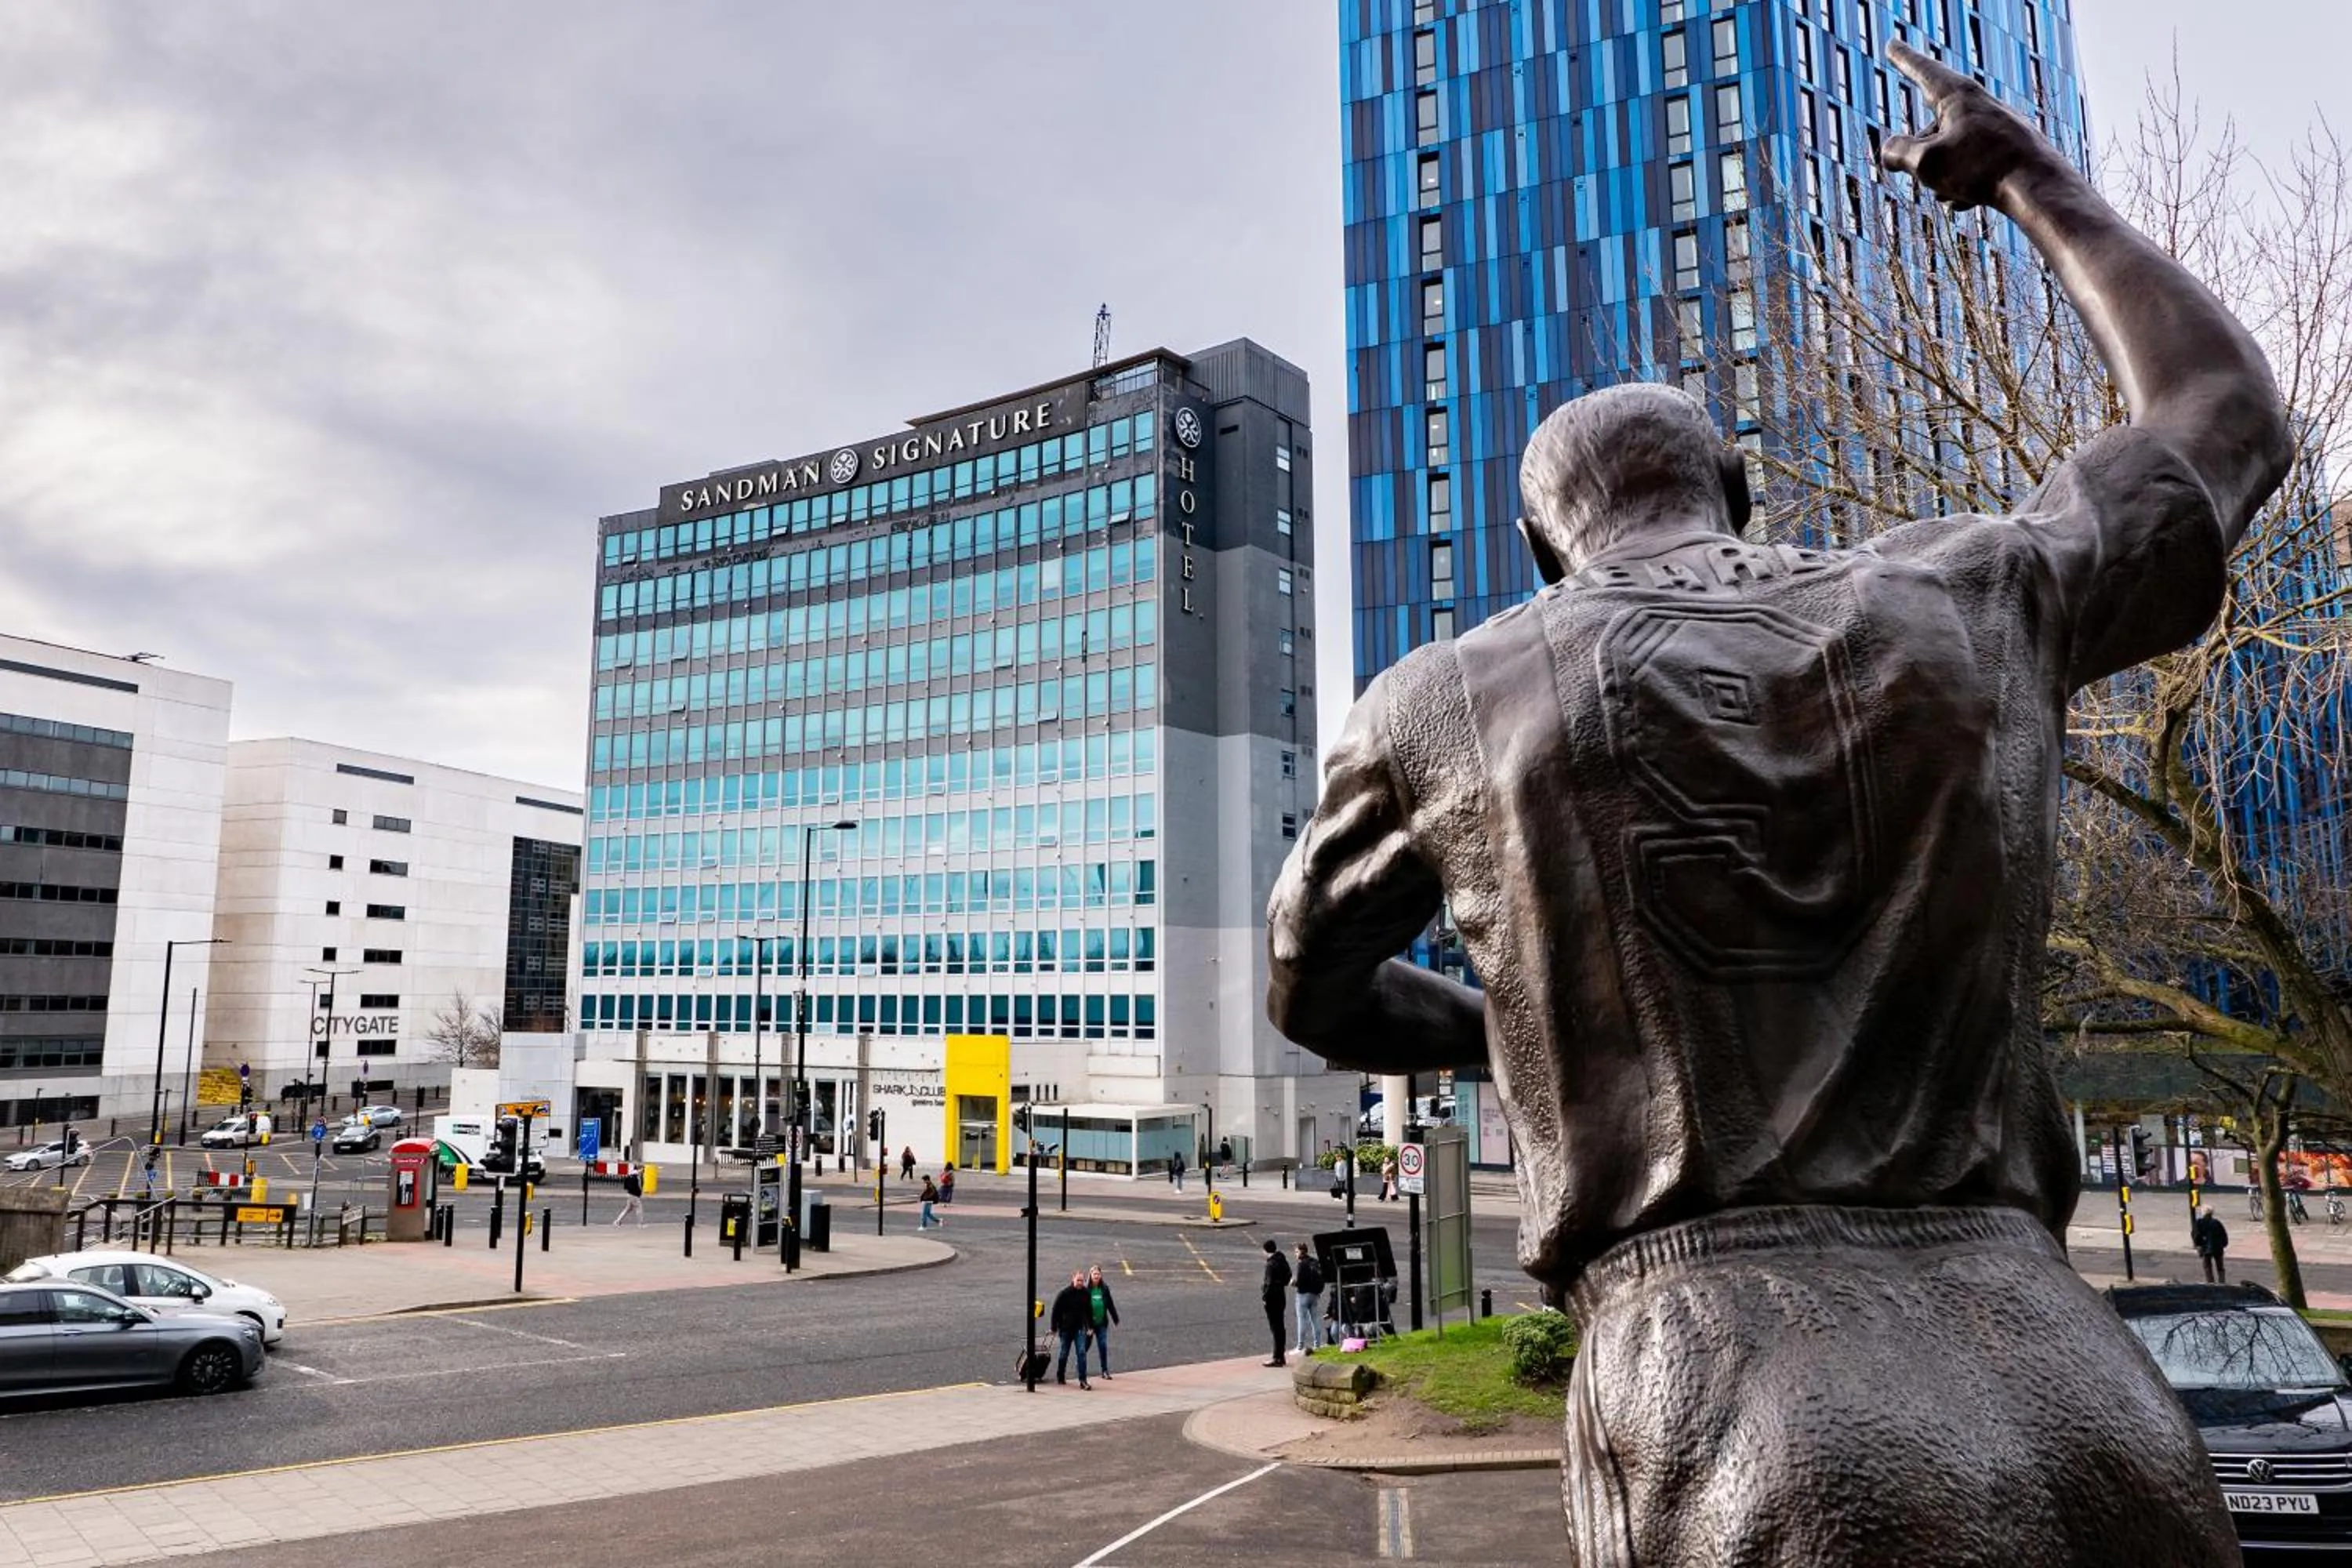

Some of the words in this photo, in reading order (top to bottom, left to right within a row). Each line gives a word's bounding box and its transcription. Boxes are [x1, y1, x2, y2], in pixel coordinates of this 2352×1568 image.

[681, 462, 821, 511] SANDMAN
[872, 402, 1051, 470] SIGNATURE
[1181, 457, 1196, 612] HOTEL
[873, 1084, 906, 1094] SHARK
[1404, 1153, 1418, 1167] 30
[2227, 1495, 2273, 1511] ND23
[2276, 1496, 2310, 1512] PYU
